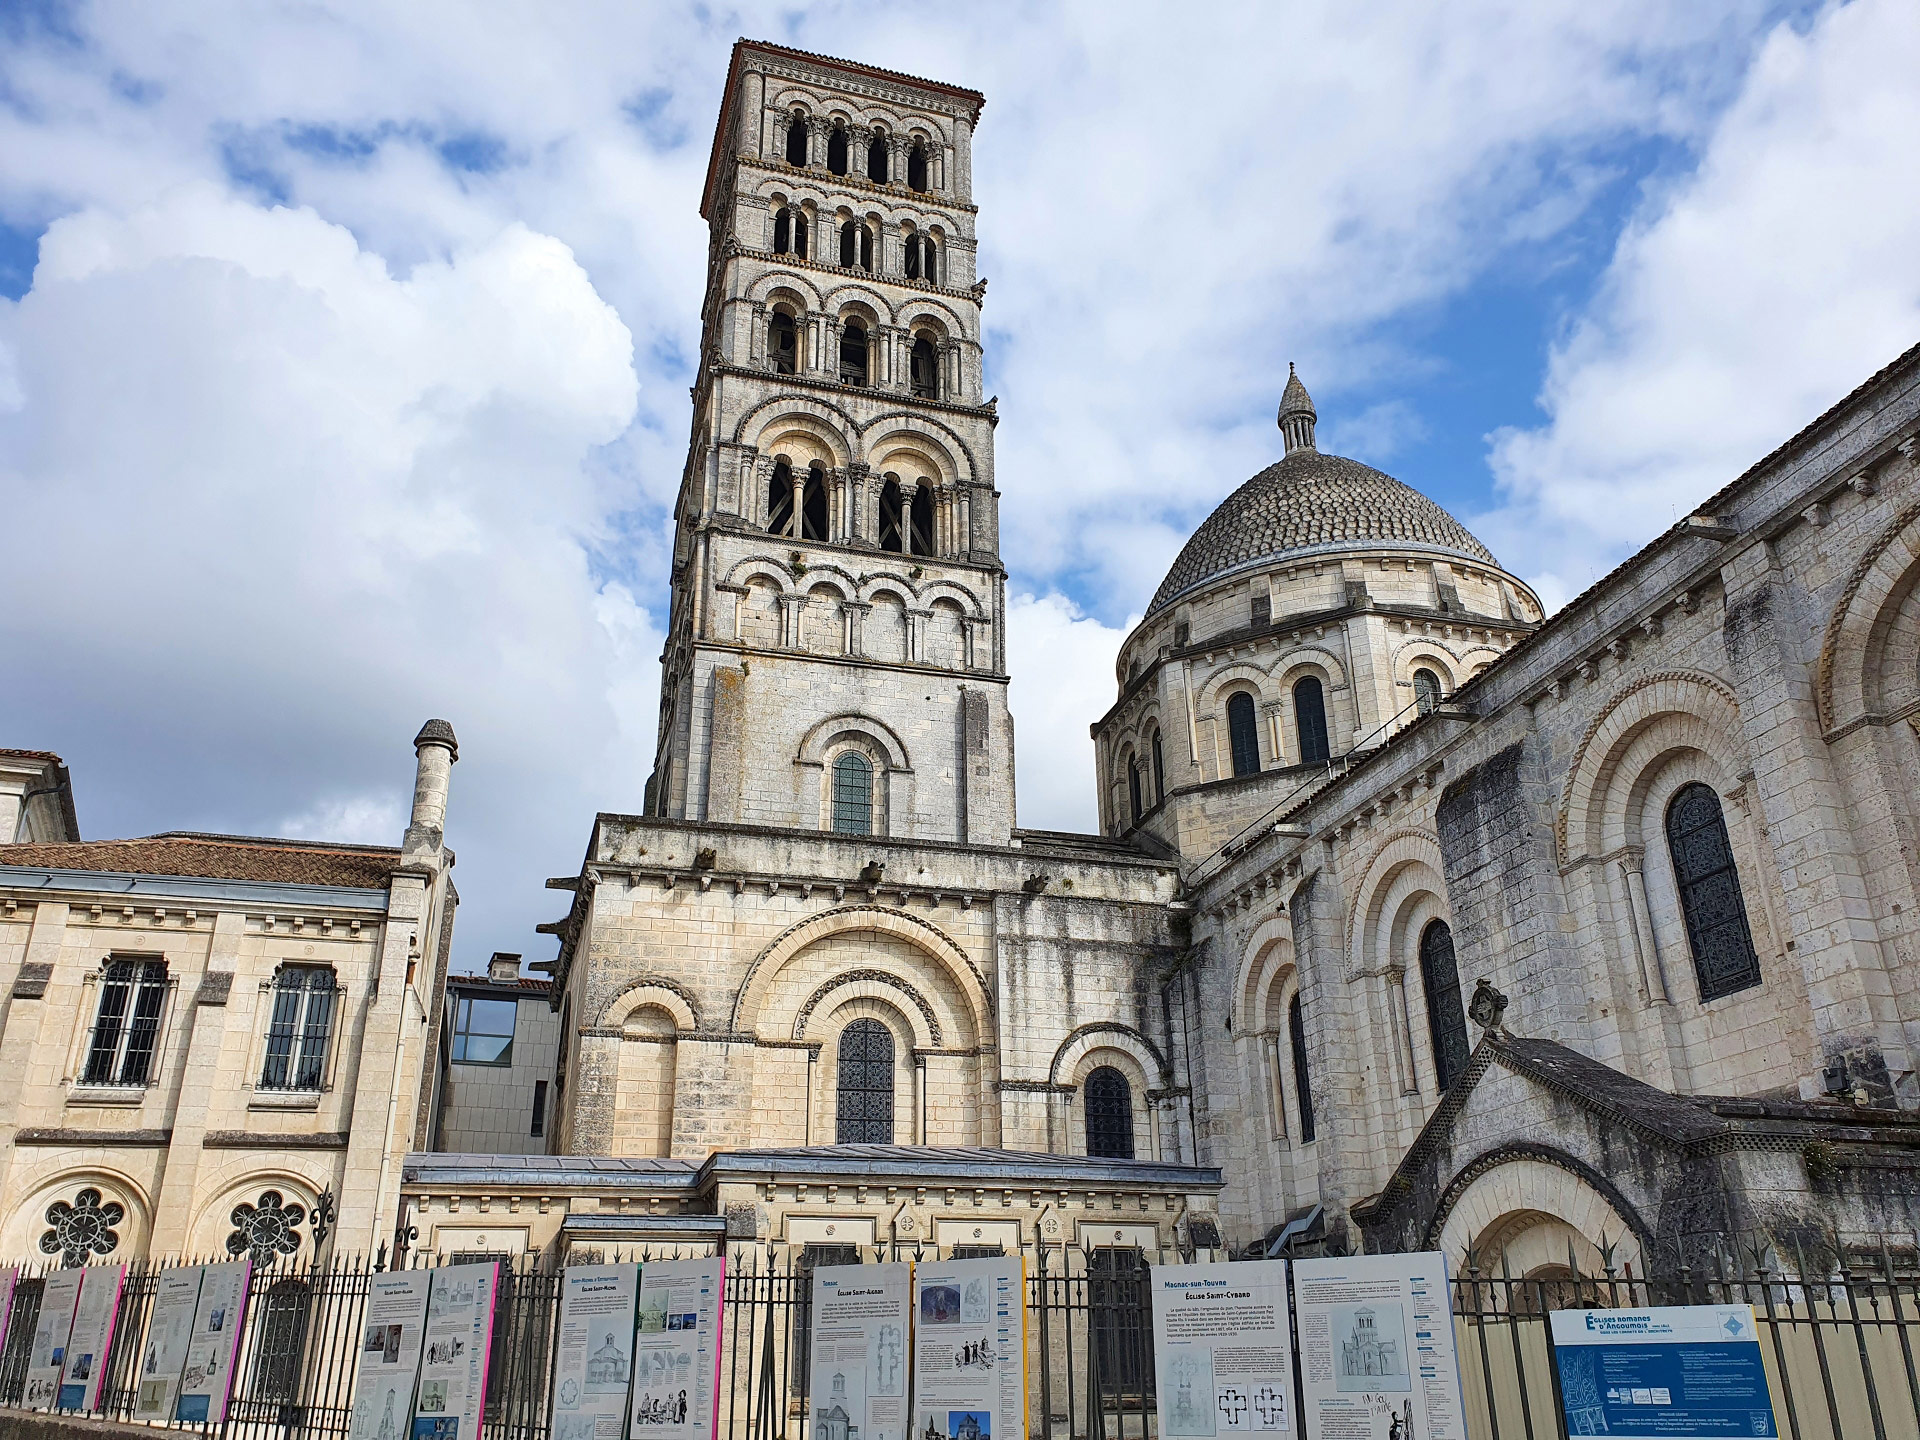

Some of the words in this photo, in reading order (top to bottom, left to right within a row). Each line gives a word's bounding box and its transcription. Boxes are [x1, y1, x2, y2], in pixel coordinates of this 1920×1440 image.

[1164, 1280, 1226, 1288] Magnac-sur-Touvre
[1186, 1292, 1205, 1300] Église
[1585, 1312, 1616, 1330] Églises
